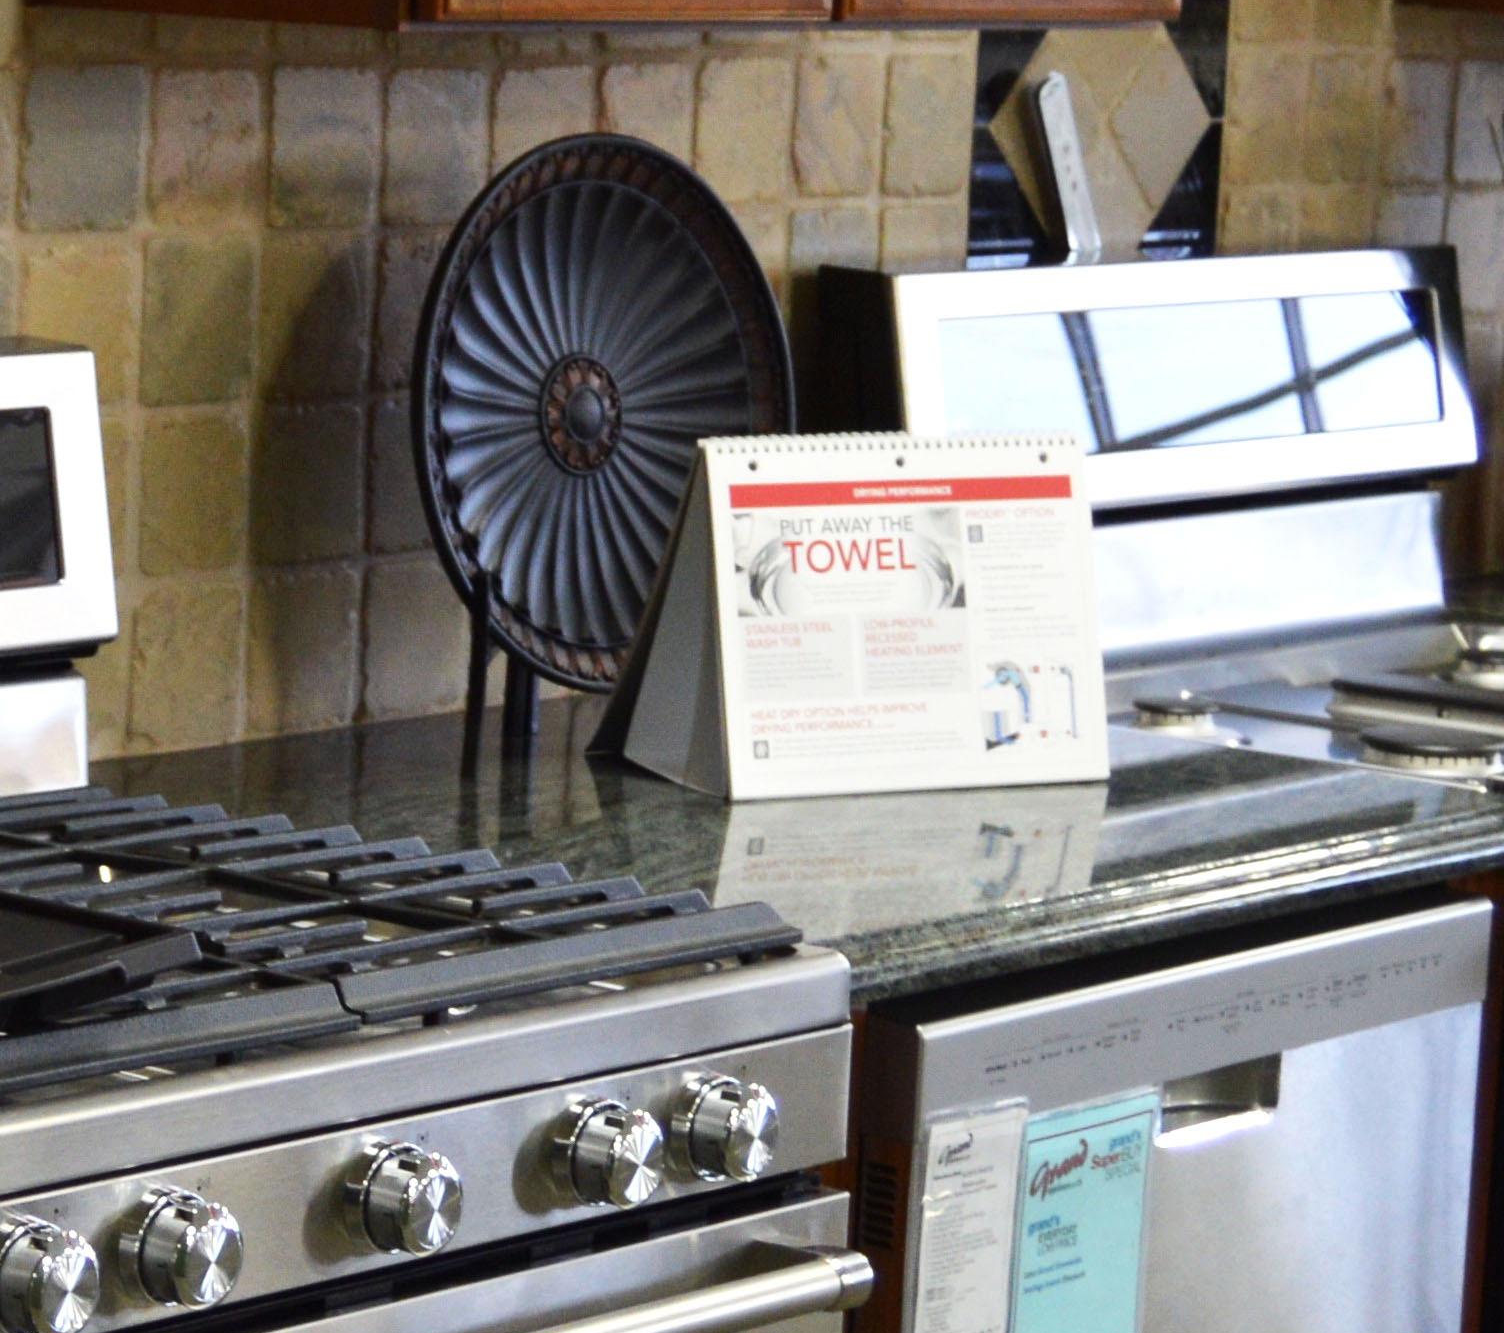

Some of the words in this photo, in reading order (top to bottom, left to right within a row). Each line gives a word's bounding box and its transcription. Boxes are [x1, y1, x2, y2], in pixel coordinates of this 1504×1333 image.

[779, 517, 815, 537] PUT
[820, 515, 874, 536] AWAY
[879, 514, 914, 533] THE
[782, 537, 917, 574] TOWEL
[803, 704, 846, 719] OPTION
[795, 719, 874, 734] PERFORMANCE
[1028, 1137, 1090, 1203] Grand
